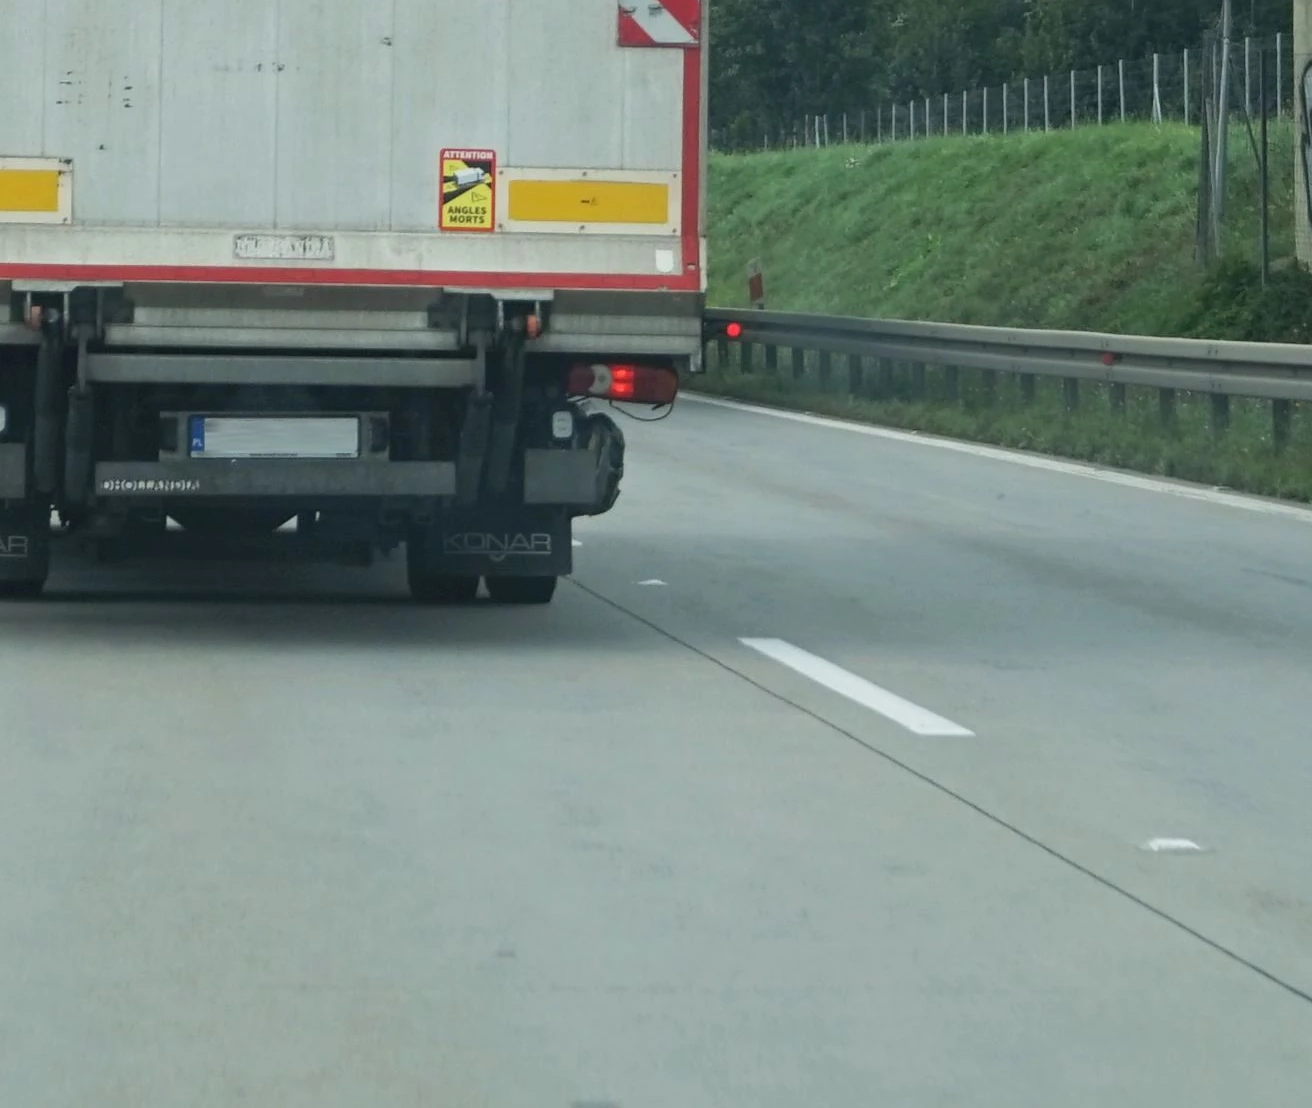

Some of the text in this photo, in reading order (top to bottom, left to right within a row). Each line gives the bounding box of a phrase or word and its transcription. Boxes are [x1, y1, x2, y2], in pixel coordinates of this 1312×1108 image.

[443, 151, 493, 160] ATTENTION
[447, 206, 487, 215] ANGLES
[449, 215, 485, 224] MORTS
[443, 532, 552, 551] KONAR
